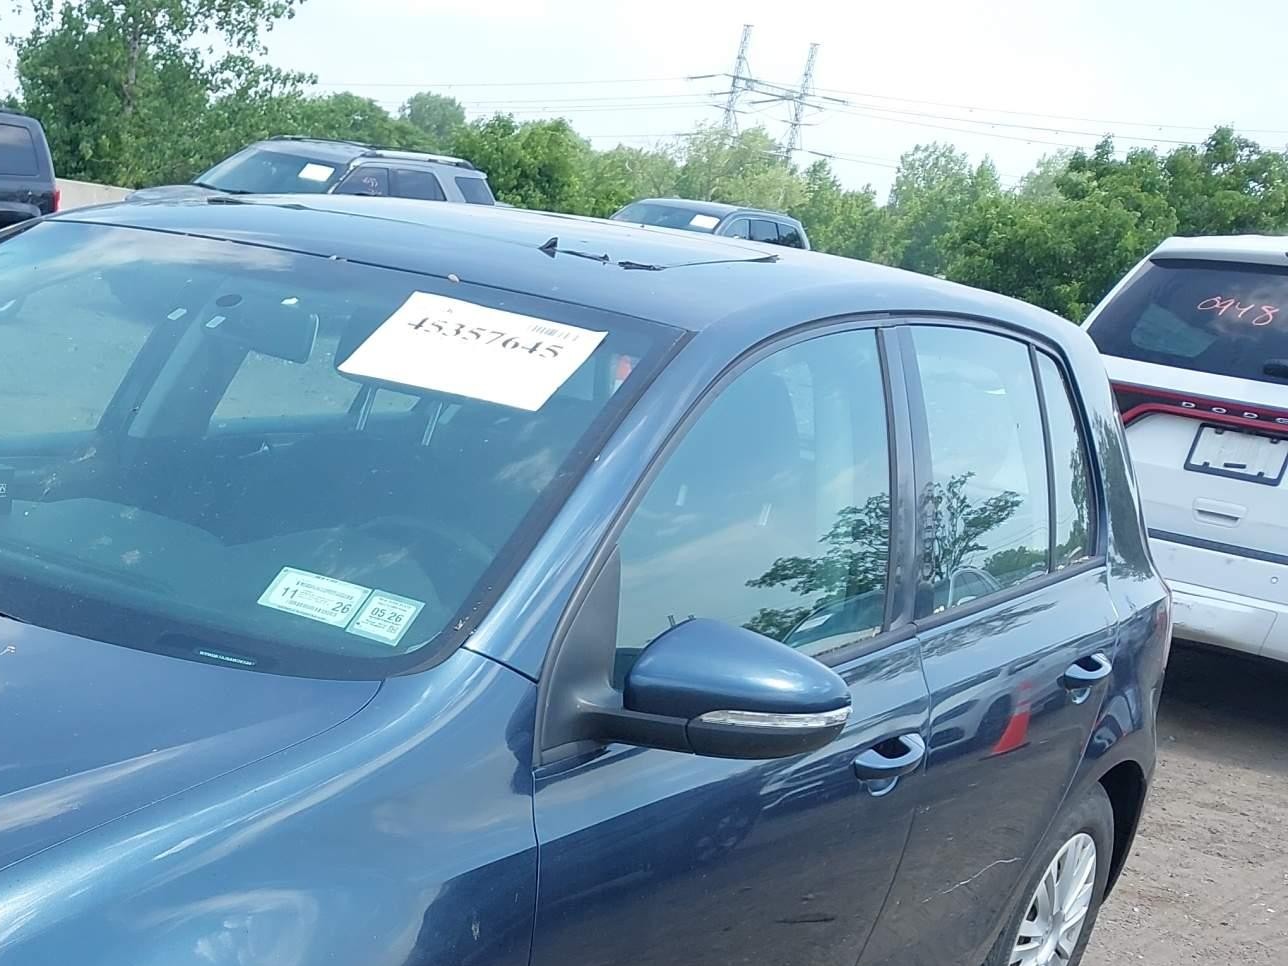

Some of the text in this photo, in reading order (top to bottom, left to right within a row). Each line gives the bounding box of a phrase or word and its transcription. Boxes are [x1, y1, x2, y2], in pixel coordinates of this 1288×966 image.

[407, 316, 564, 360] 45357645
[331, 601, 352, 614] 26
[370, 607, 388, 618] 05
[387, 611, 405, 623] 26
